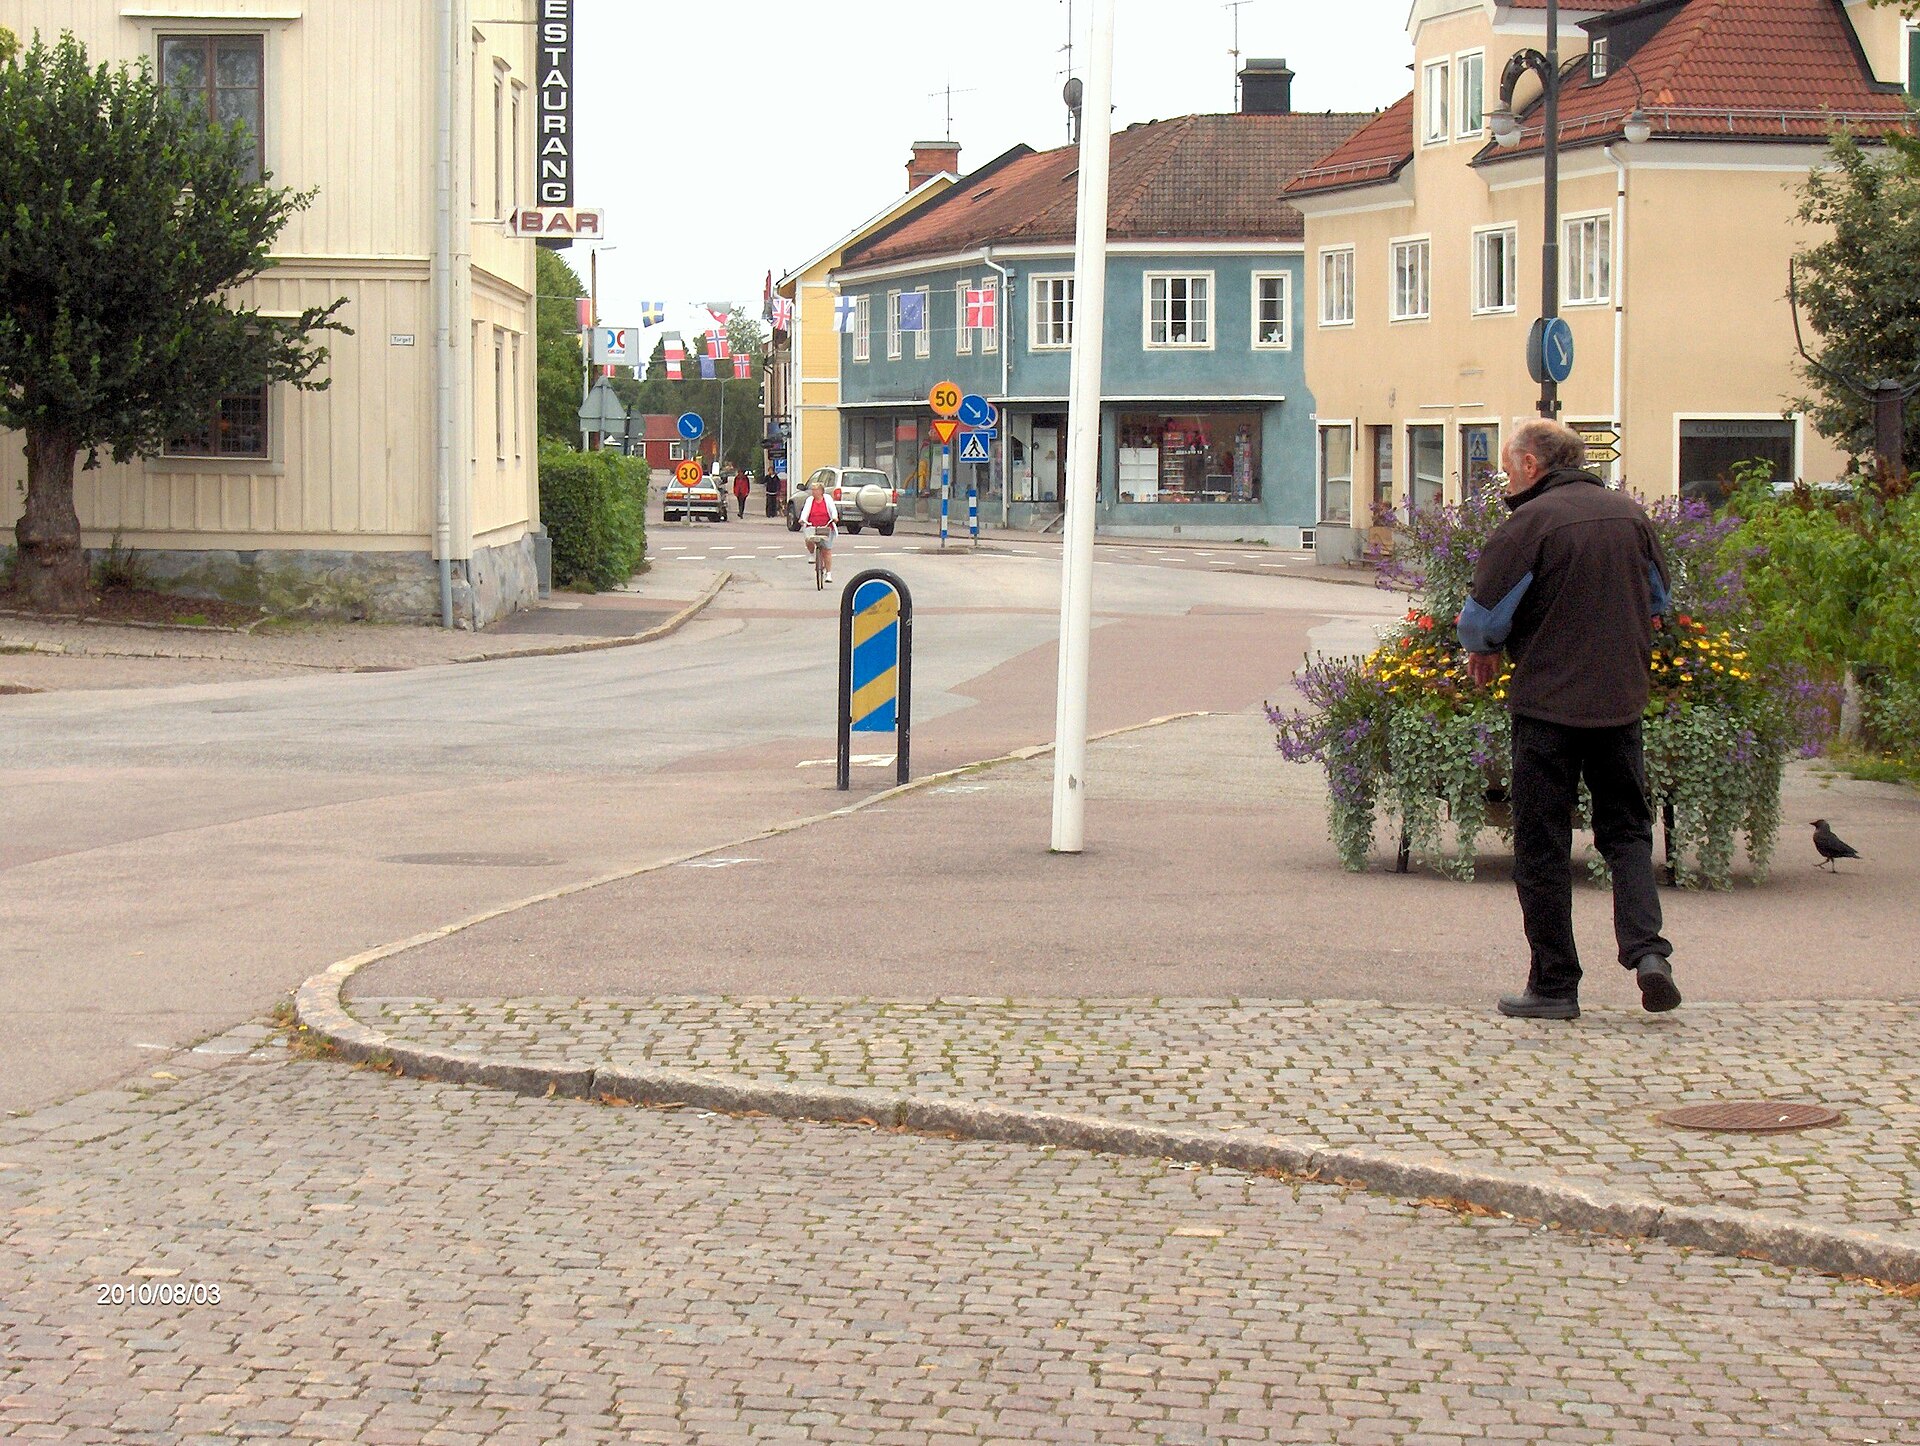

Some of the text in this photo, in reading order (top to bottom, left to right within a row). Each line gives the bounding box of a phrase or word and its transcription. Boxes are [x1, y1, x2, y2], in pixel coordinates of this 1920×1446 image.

[542, 0, 568, 202] ESTAURANG
[521, 211, 598, 233] BAR
[935, 391, 958, 407] 50
[1584, 433, 1603, 442] ariat
[1584, 450, 1611, 460] antverk
[680, 467, 698, 480] 30
